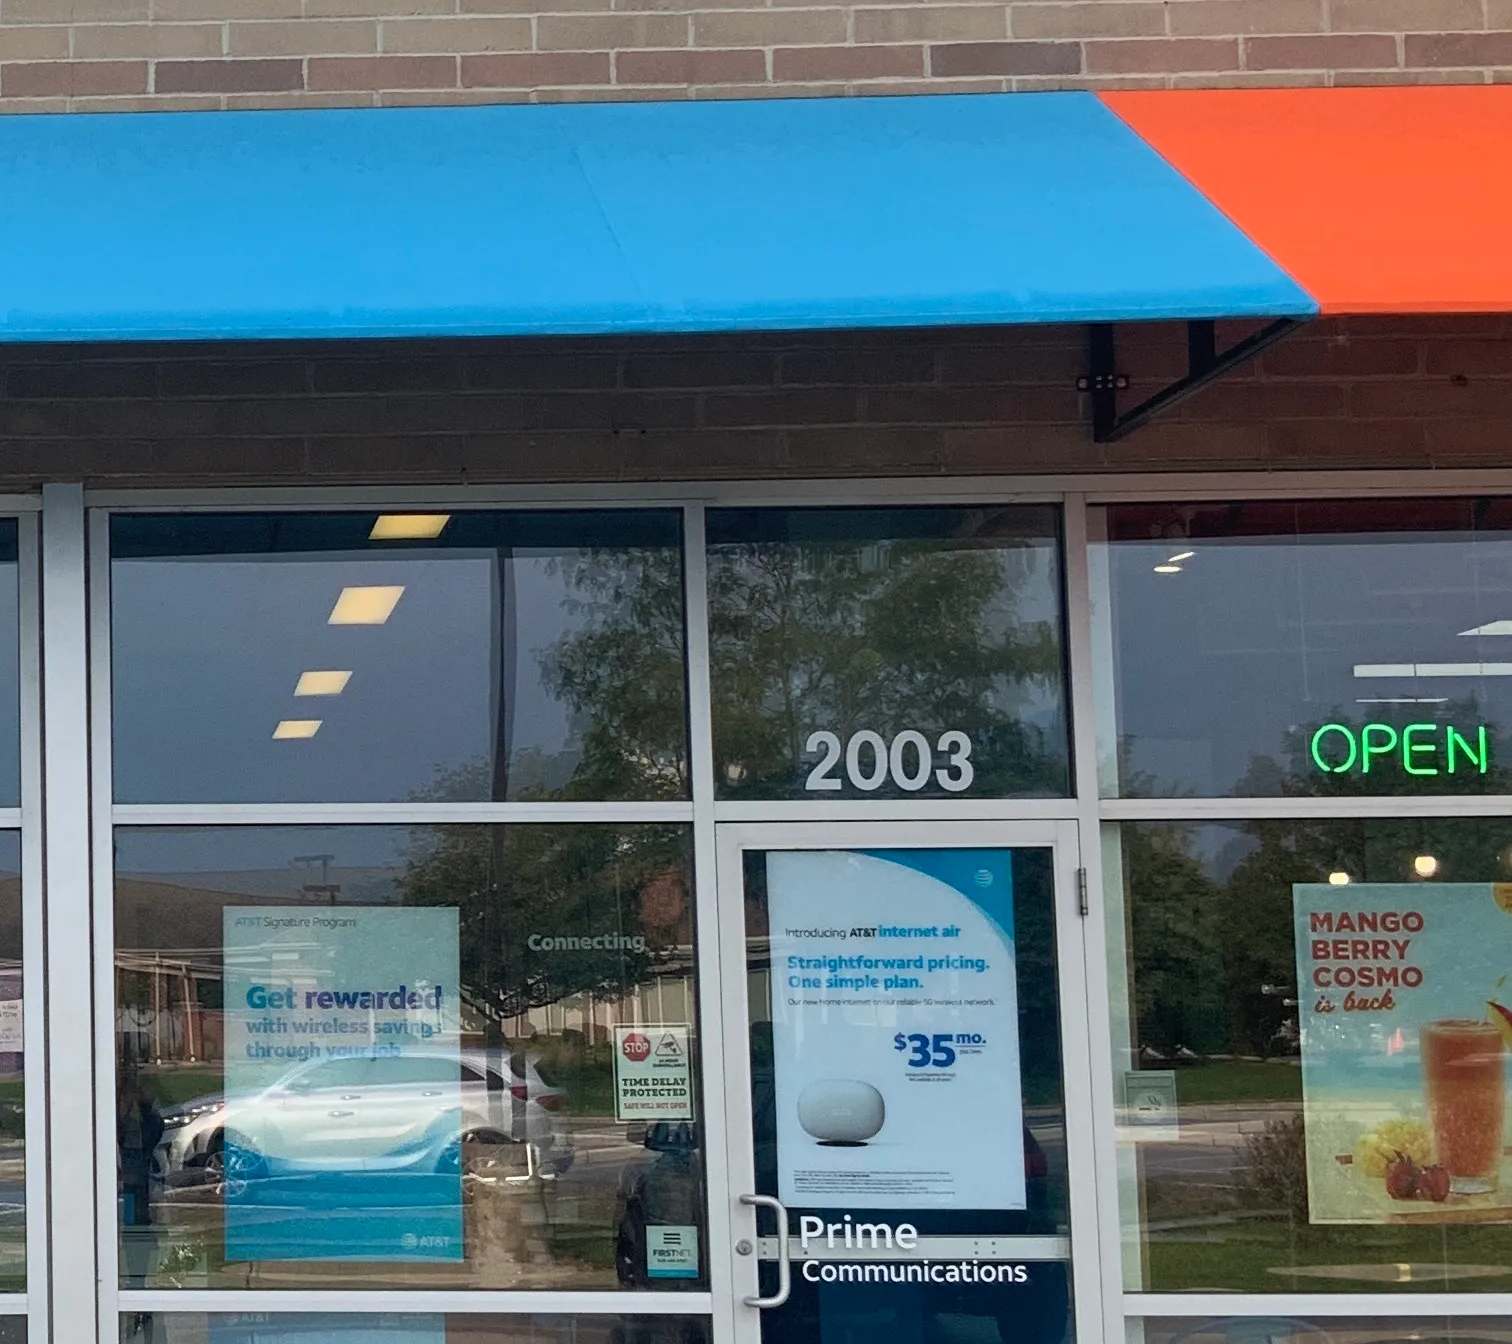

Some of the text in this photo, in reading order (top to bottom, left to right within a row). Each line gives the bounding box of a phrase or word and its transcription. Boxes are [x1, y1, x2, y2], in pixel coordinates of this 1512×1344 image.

[1311, 723, 1487, 775] OPEN
[804, 729, 974, 792] 2003
[263, 916, 311, 929] Signature
[312, 916, 356, 929] Program
[785, 924, 962, 940] Introducing AT&T internet air
[1309, 911, 1424, 933] MANGO
[527, 932, 645, 954] Connecting
[1311, 939, 1411, 960] BERRY
[787, 955, 991, 973] Straightforward pricing.
[788, 974, 924, 992] One simple plan.
[1313, 966, 1423, 988] COSMO
[246, 984, 443, 1011] Get rewarded
[1314, 988, 1396, 1013] is back
[246, 1017, 443, 1038] with wireless savings
[246, 1041, 320, 1061] through
[623, 1042, 649, 1053] STOP
[893, 1032, 987, 1068] $35 mo.
[621, 1077, 687, 1087] TIME DELAY
[621, 1088, 687, 1097] PROTECTED
[419, 1236, 451, 1248] AT&T
[799, 1214, 918, 1250] Prime
[801, 1259, 1028, 1284] Communications
